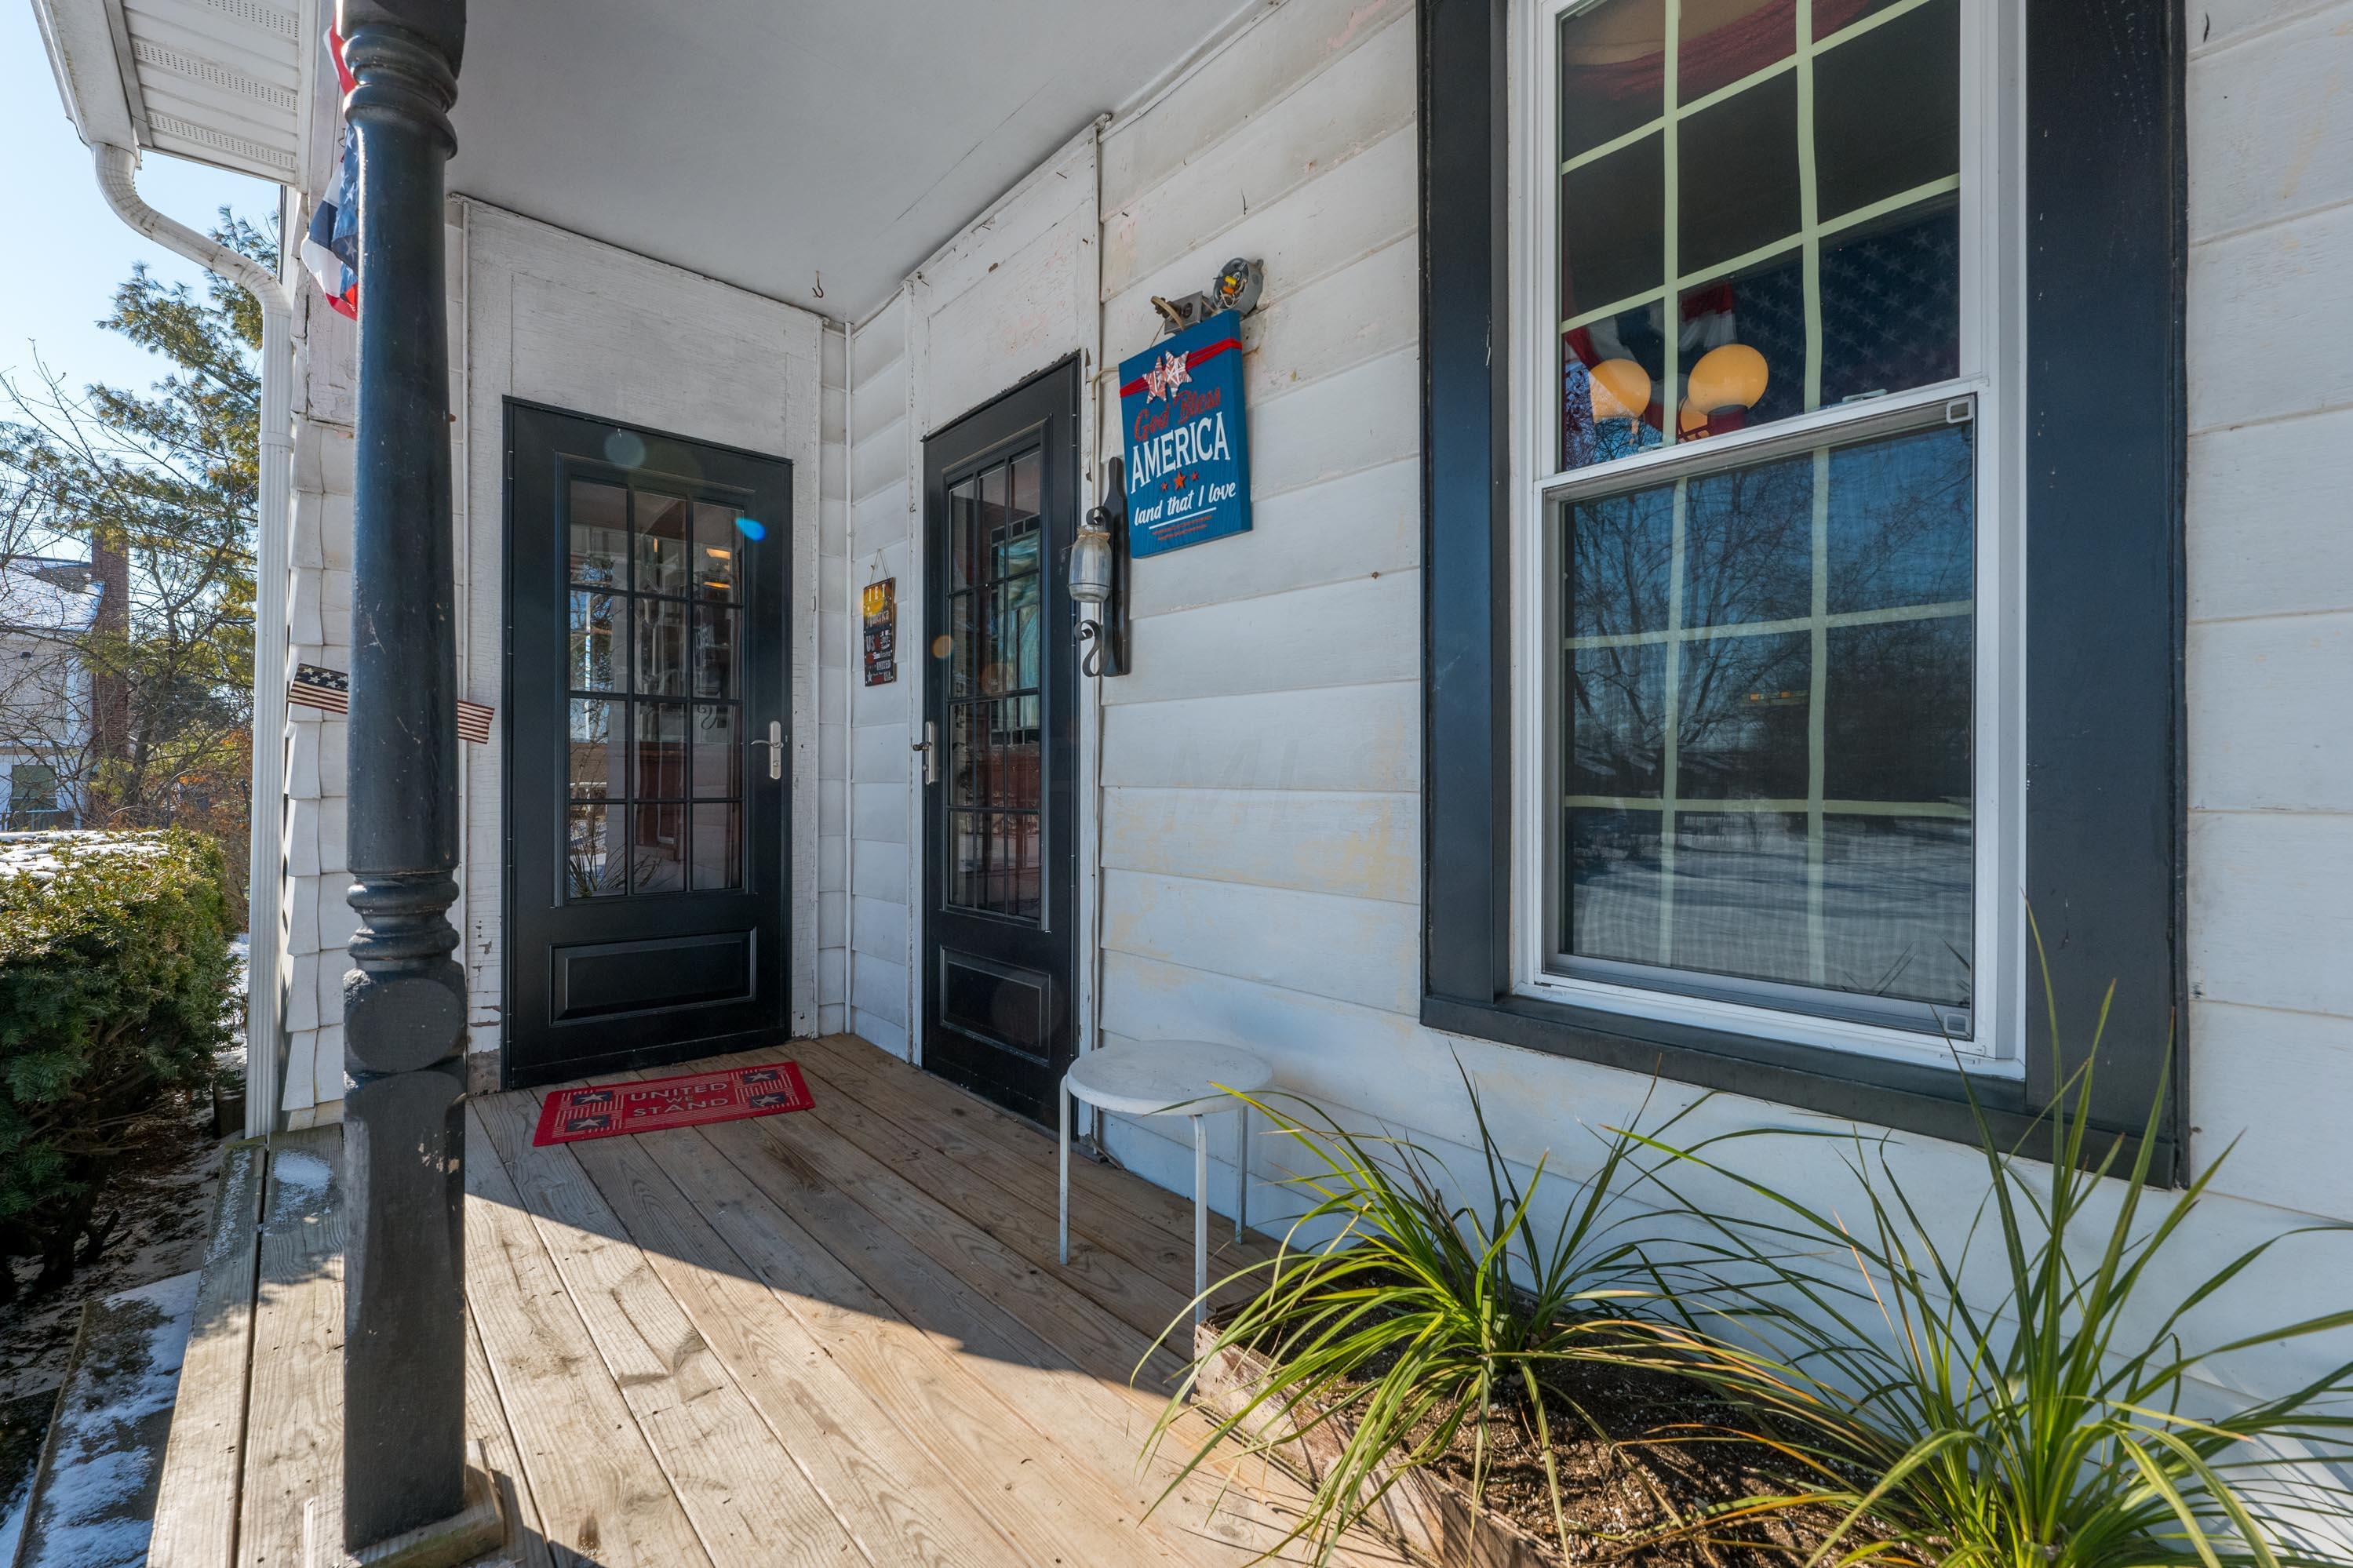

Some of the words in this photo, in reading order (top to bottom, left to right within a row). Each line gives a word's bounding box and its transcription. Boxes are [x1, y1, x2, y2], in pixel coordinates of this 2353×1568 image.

[1134, 402, 1170, 442] God
[1173, 386, 1222, 425] Bless
[1131, 411, 1230, 494] AMERICA
[1134, 500, 1164, 526] land
[1167, 489, 1194, 516] that
[1198, 485, 1205, 507] I
[1208, 482, 1237, 504] love
[630, 1082, 728, 1101] UNITED
[633, 1097, 729, 1117] STAND
[666, 1095, 694, 1104] WE
